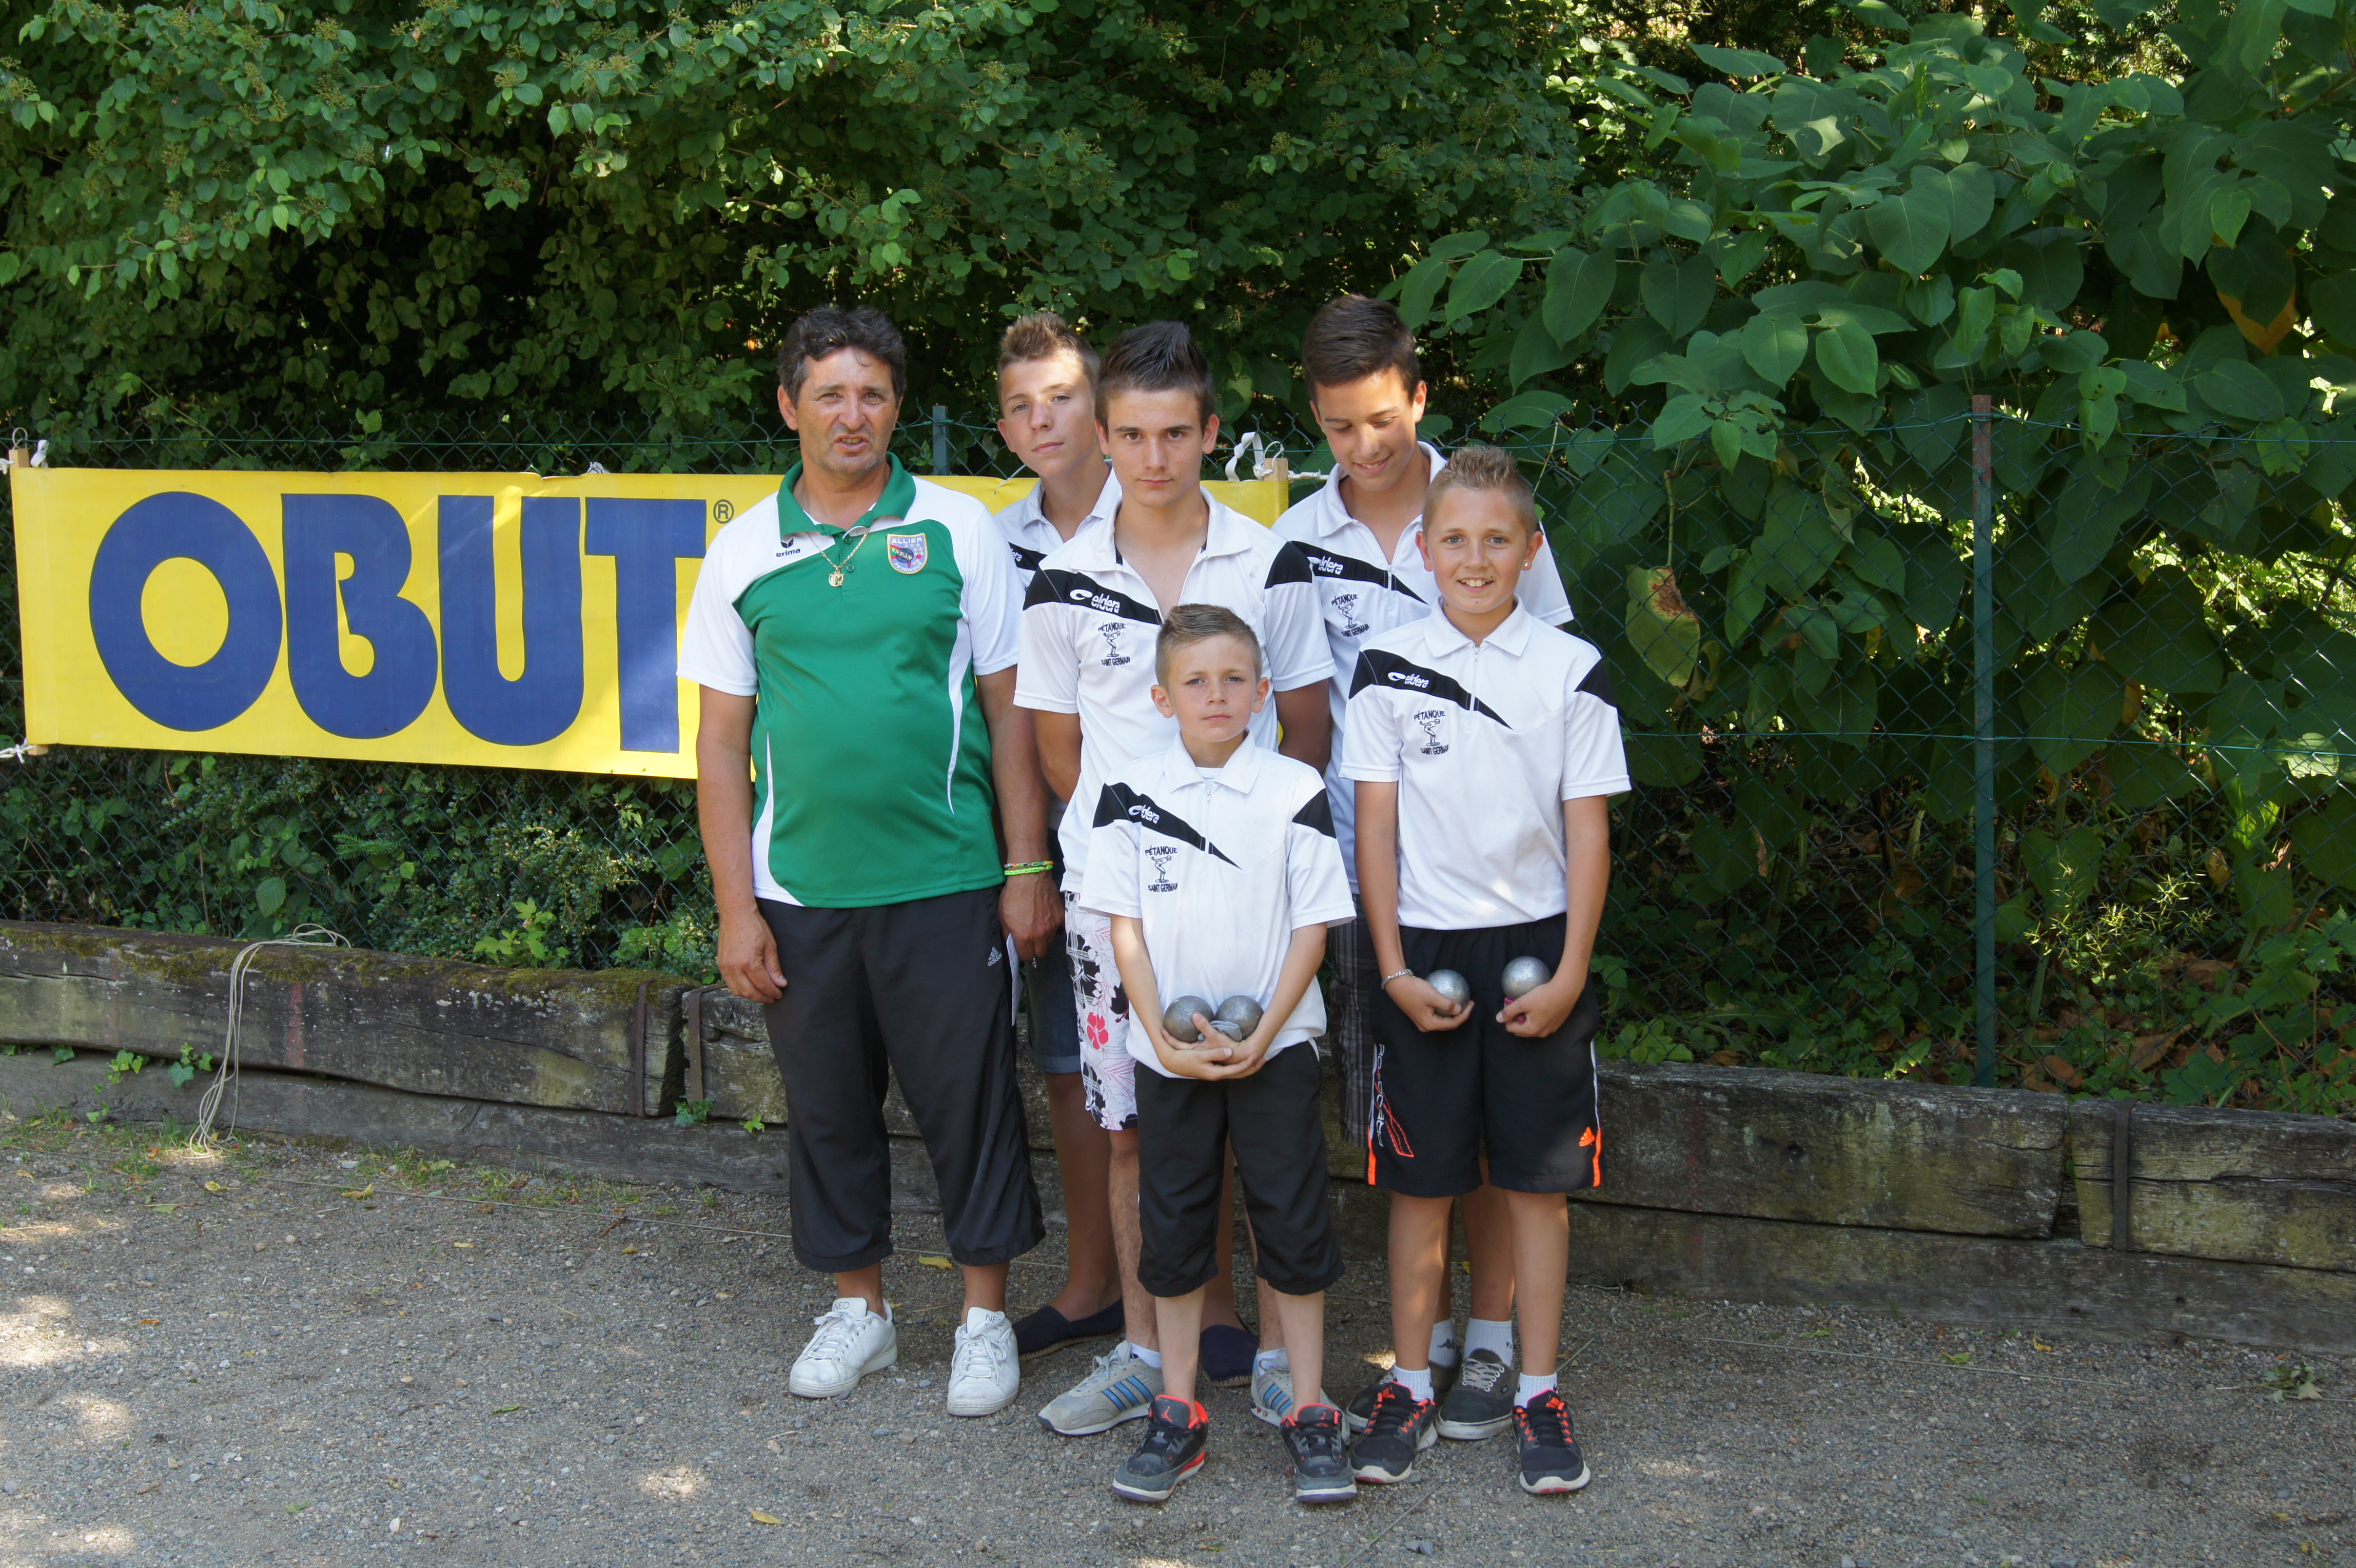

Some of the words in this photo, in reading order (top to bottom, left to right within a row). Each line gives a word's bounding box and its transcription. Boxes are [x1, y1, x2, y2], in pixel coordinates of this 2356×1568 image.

[776, 548, 801, 558] erima
[894, 562, 922, 572] PETANQUE
[1091, 593, 1121, 614] eldera
[89, 491, 706, 754] OBUT
[1404, 673, 1429, 688] eldera
[1413, 710, 1446, 721] PÉTANQUE
[1145, 845, 1178, 856] PÉTANQUE
[834, 1301, 850, 1310] NEO
